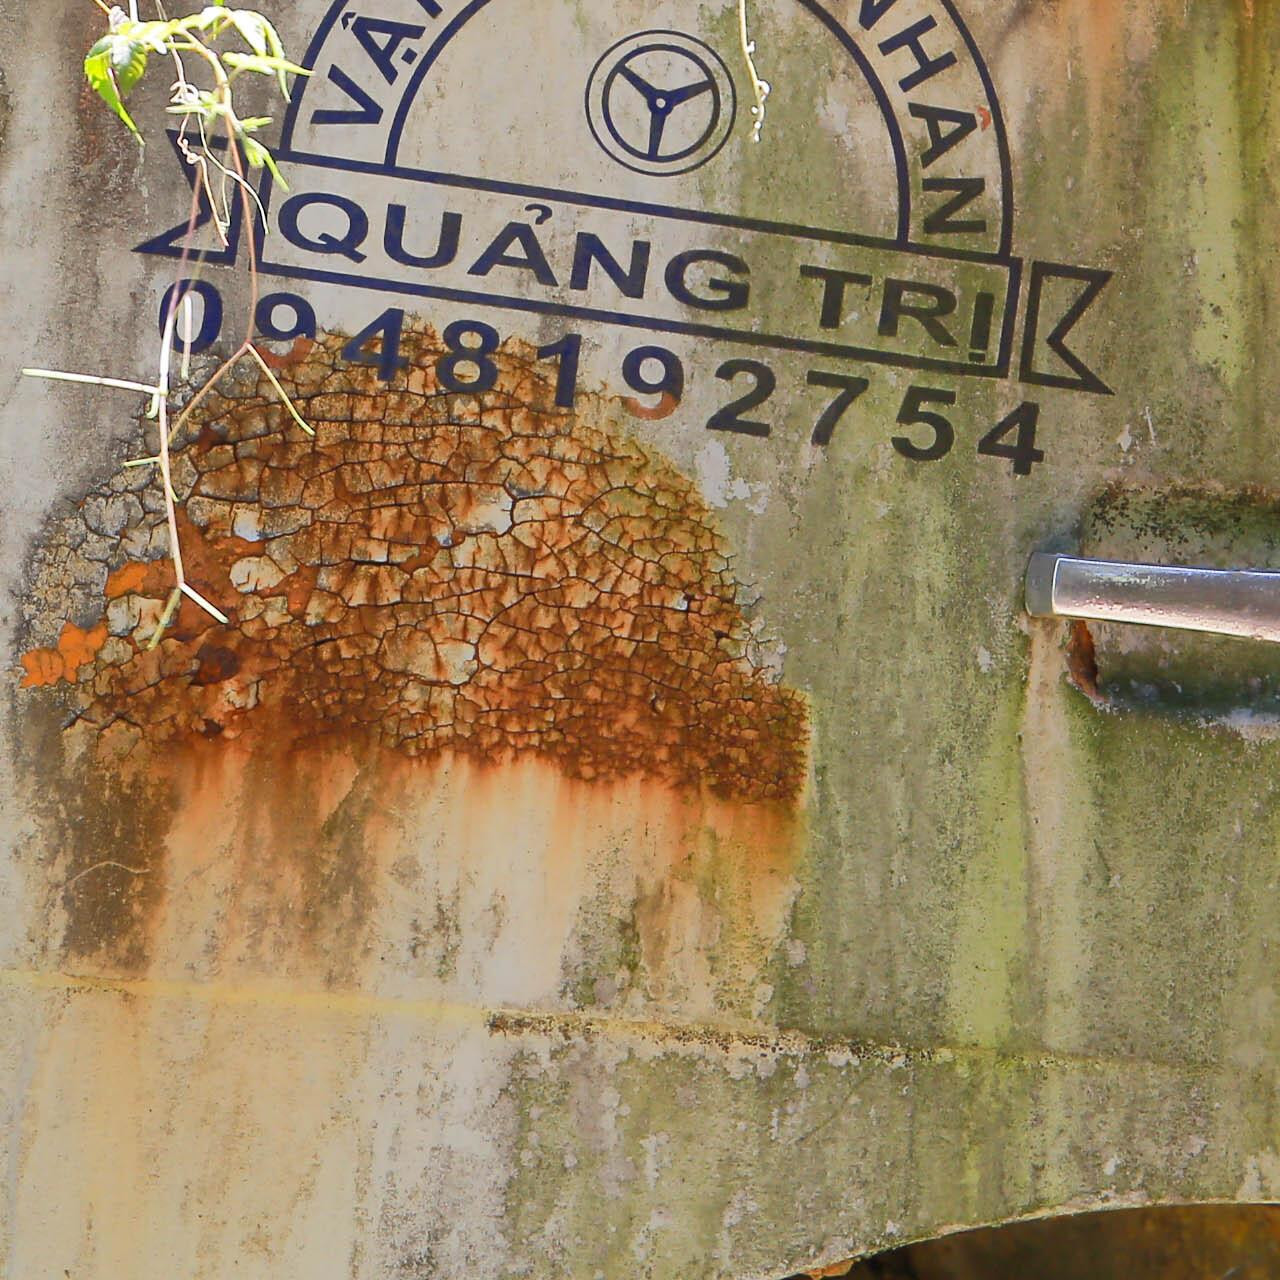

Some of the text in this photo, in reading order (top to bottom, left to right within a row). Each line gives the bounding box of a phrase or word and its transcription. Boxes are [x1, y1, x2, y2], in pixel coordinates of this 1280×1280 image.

[277, 192, 995, 362] QUẢNG TRỊ
[158, 278, 1045, 477] 0948192754
